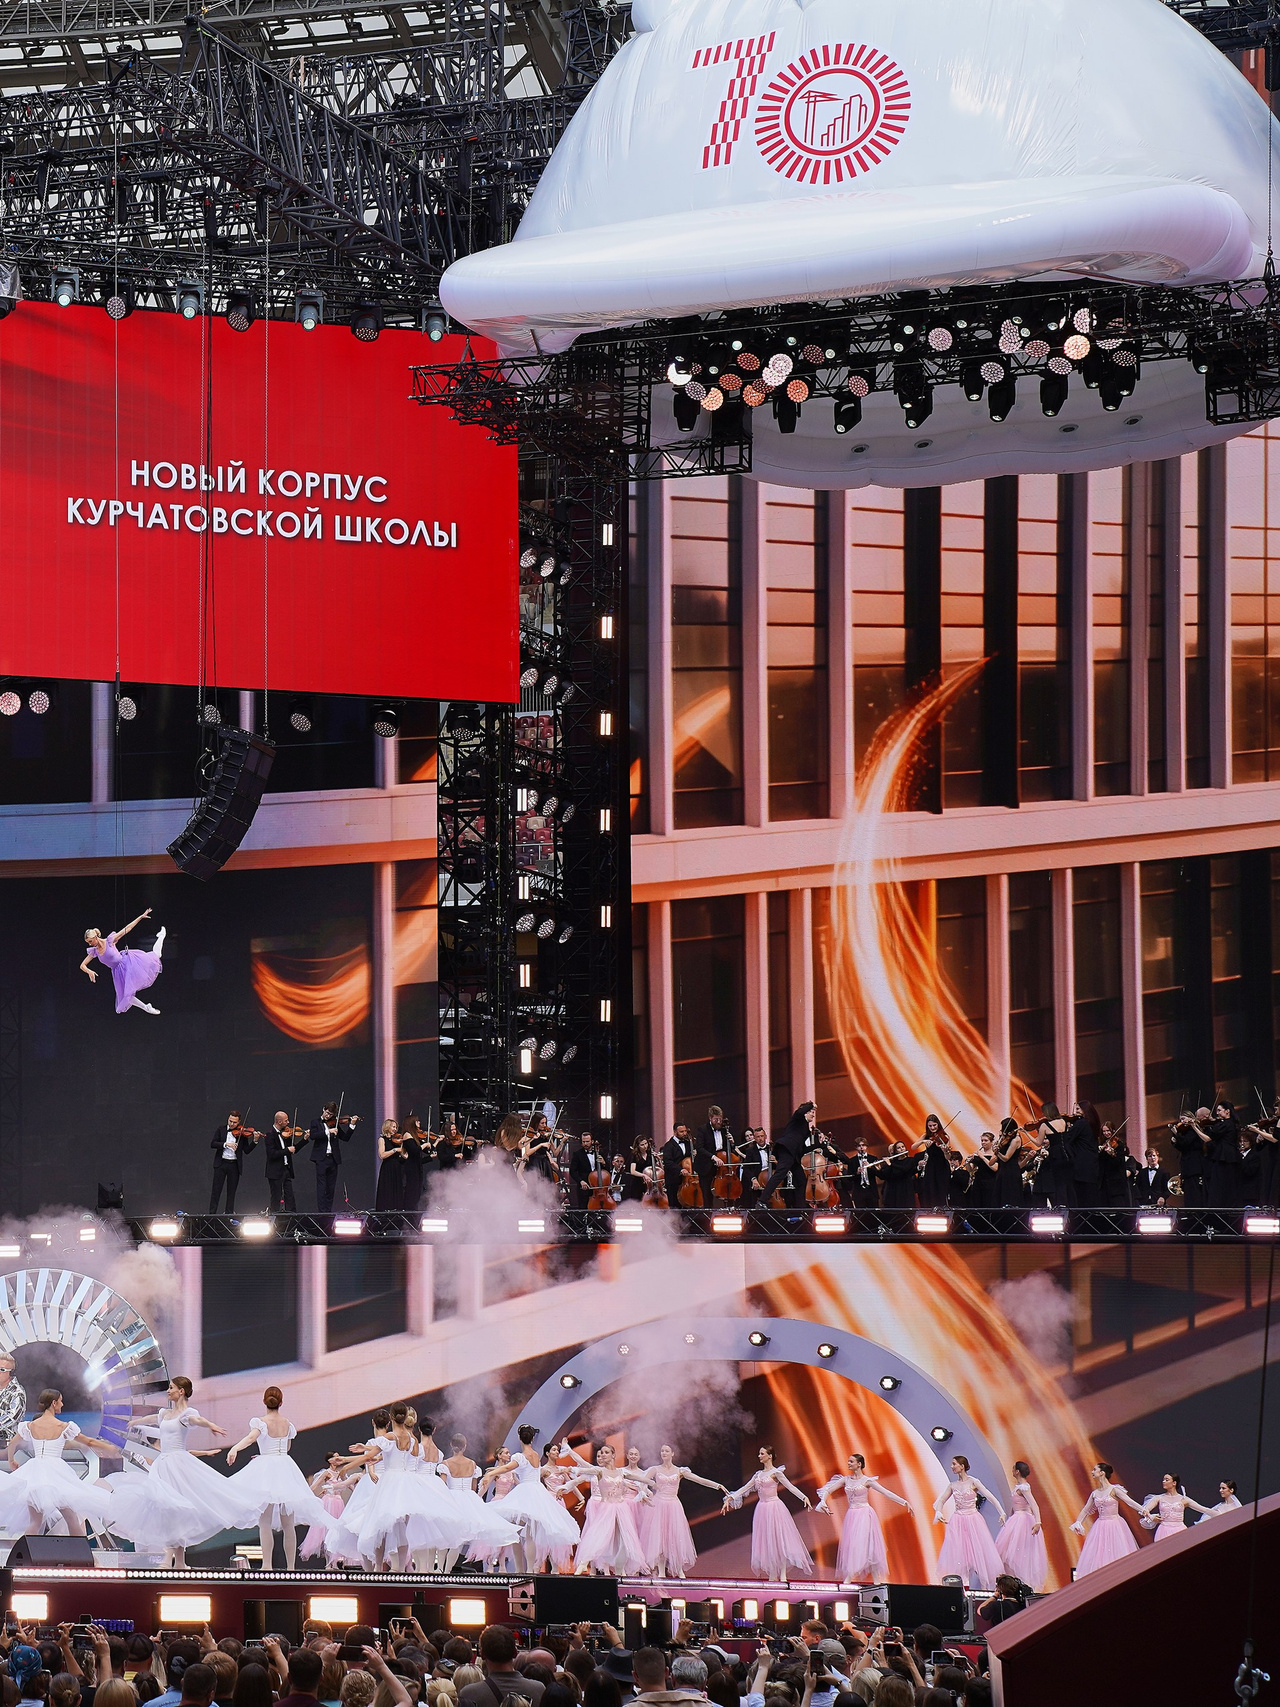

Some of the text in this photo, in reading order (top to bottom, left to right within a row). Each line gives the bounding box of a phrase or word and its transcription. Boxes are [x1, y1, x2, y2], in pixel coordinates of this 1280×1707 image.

[131, 459, 389, 503] НОВЫЙ КОРПУС
[66, 496, 458, 548] КУРЧАТОВСКОЙ ШКОЛЫ
